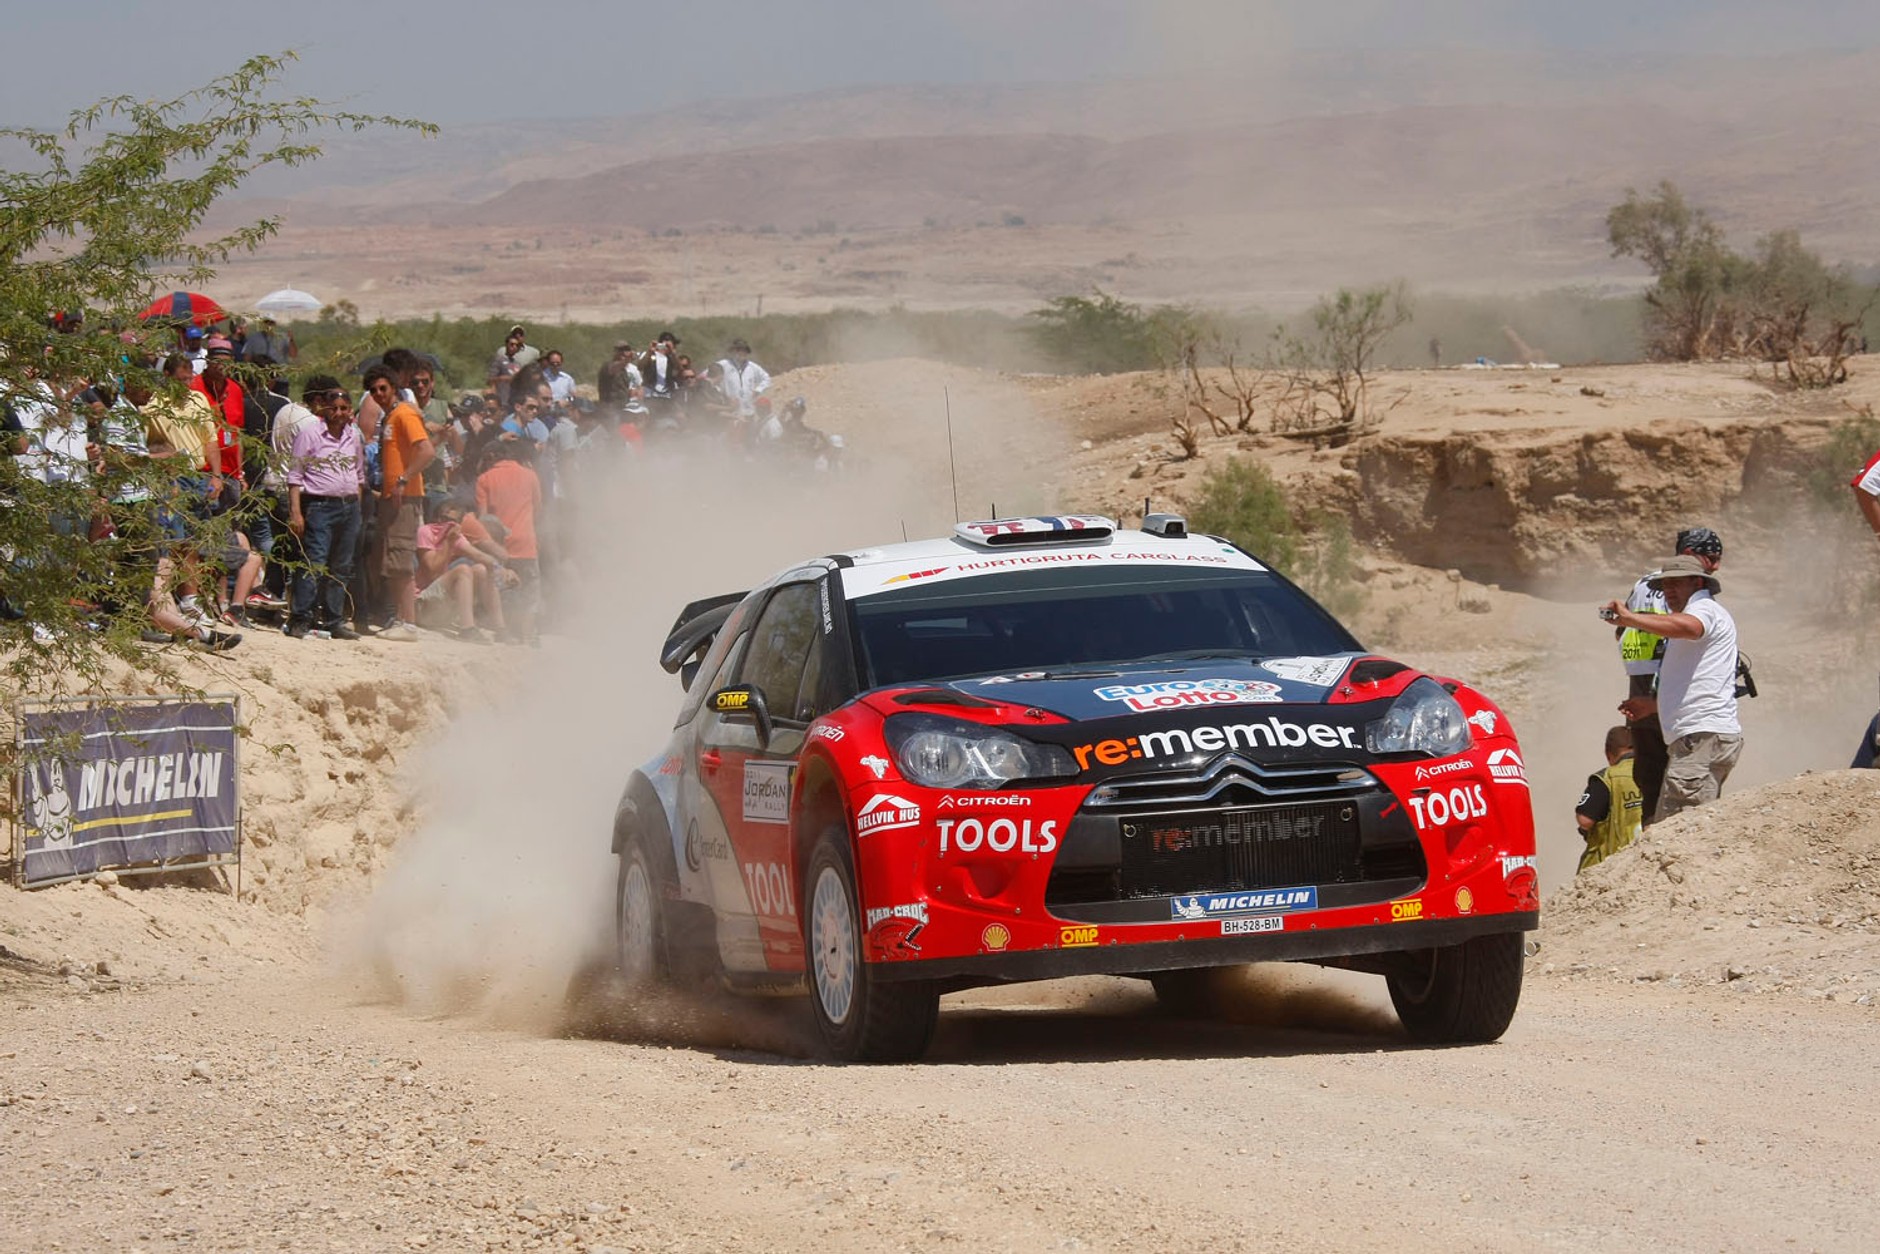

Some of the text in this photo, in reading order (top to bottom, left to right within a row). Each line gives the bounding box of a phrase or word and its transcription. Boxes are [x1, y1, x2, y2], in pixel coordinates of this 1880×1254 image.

[957, 552, 1227, 572] HURTIGRUTA CARGLASS
[716, 692, 749, 706] OMP
[78, 752, 222, 812] MICHELIN
[744, 780, 786, 801] JORDAN
[1409, 784, 1487, 829] TOOLS
[857, 807, 921, 831] HELLVIK HUS
[936, 818, 1057, 853] TOOLS
[1208, 890, 1310, 911] MICHELIN
[1391, 901, 1423, 918] OMP
[1060, 927, 1099, 944] OMP
[1223, 918, 1282, 933] BH-528-BM
